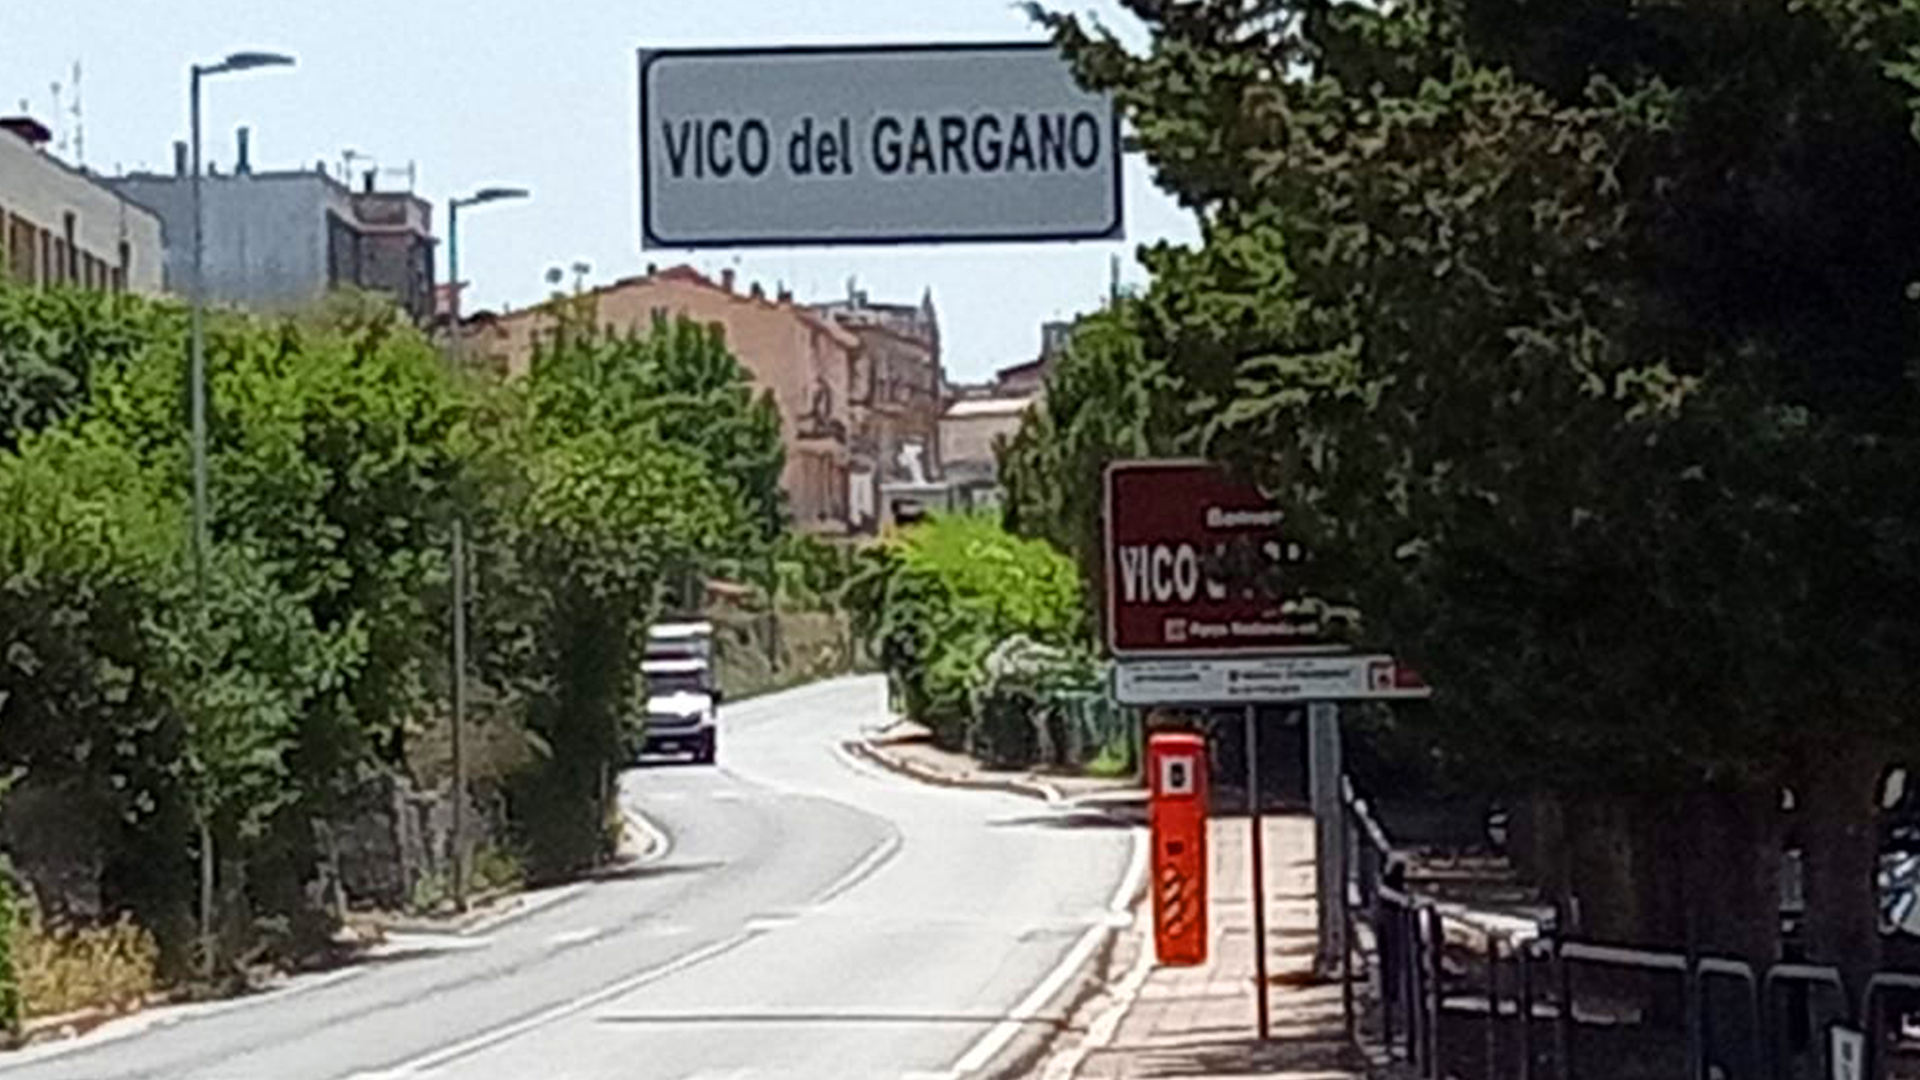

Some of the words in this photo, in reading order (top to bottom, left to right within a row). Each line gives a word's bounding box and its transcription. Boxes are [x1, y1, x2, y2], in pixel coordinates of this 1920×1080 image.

[663, 117, 769, 178] VICO
[788, 116, 853, 176] del
[871, 111, 1100, 175] GARGANO
[1119, 544, 1198, 602] VICO
